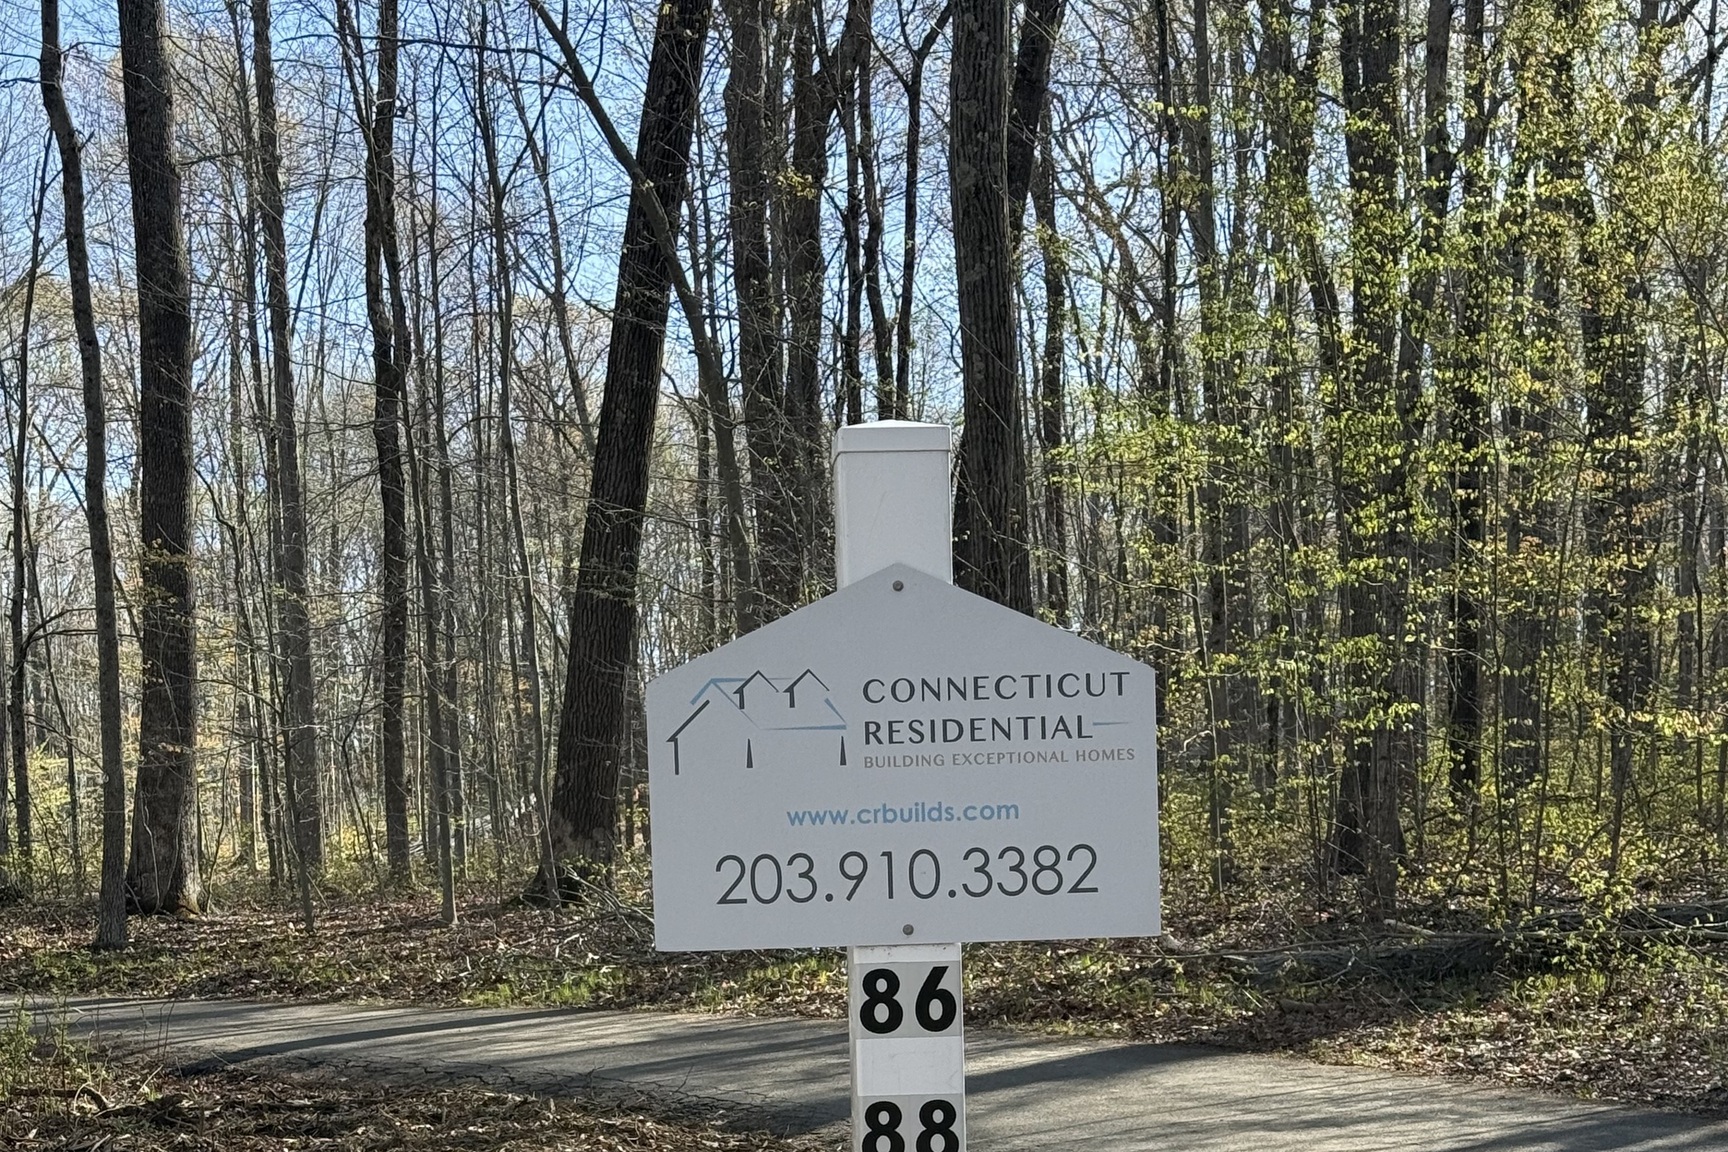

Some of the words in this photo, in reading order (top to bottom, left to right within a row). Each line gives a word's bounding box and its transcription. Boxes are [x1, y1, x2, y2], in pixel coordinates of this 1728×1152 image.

[862, 671, 1131, 704] CONNECTICUT
[863, 714, 1094, 746] RESIDENTIAL
[863, 752, 946, 769] BUILDING
[952, 749, 1070, 766] EXCEPTIONAL
[1075, 747, 1136, 763] HOMES
[786, 801, 1020, 827] www.crbuilds.com
[715, 843, 1100, 905] 203.910.3382
[859, 965, 958, 1034] 86
